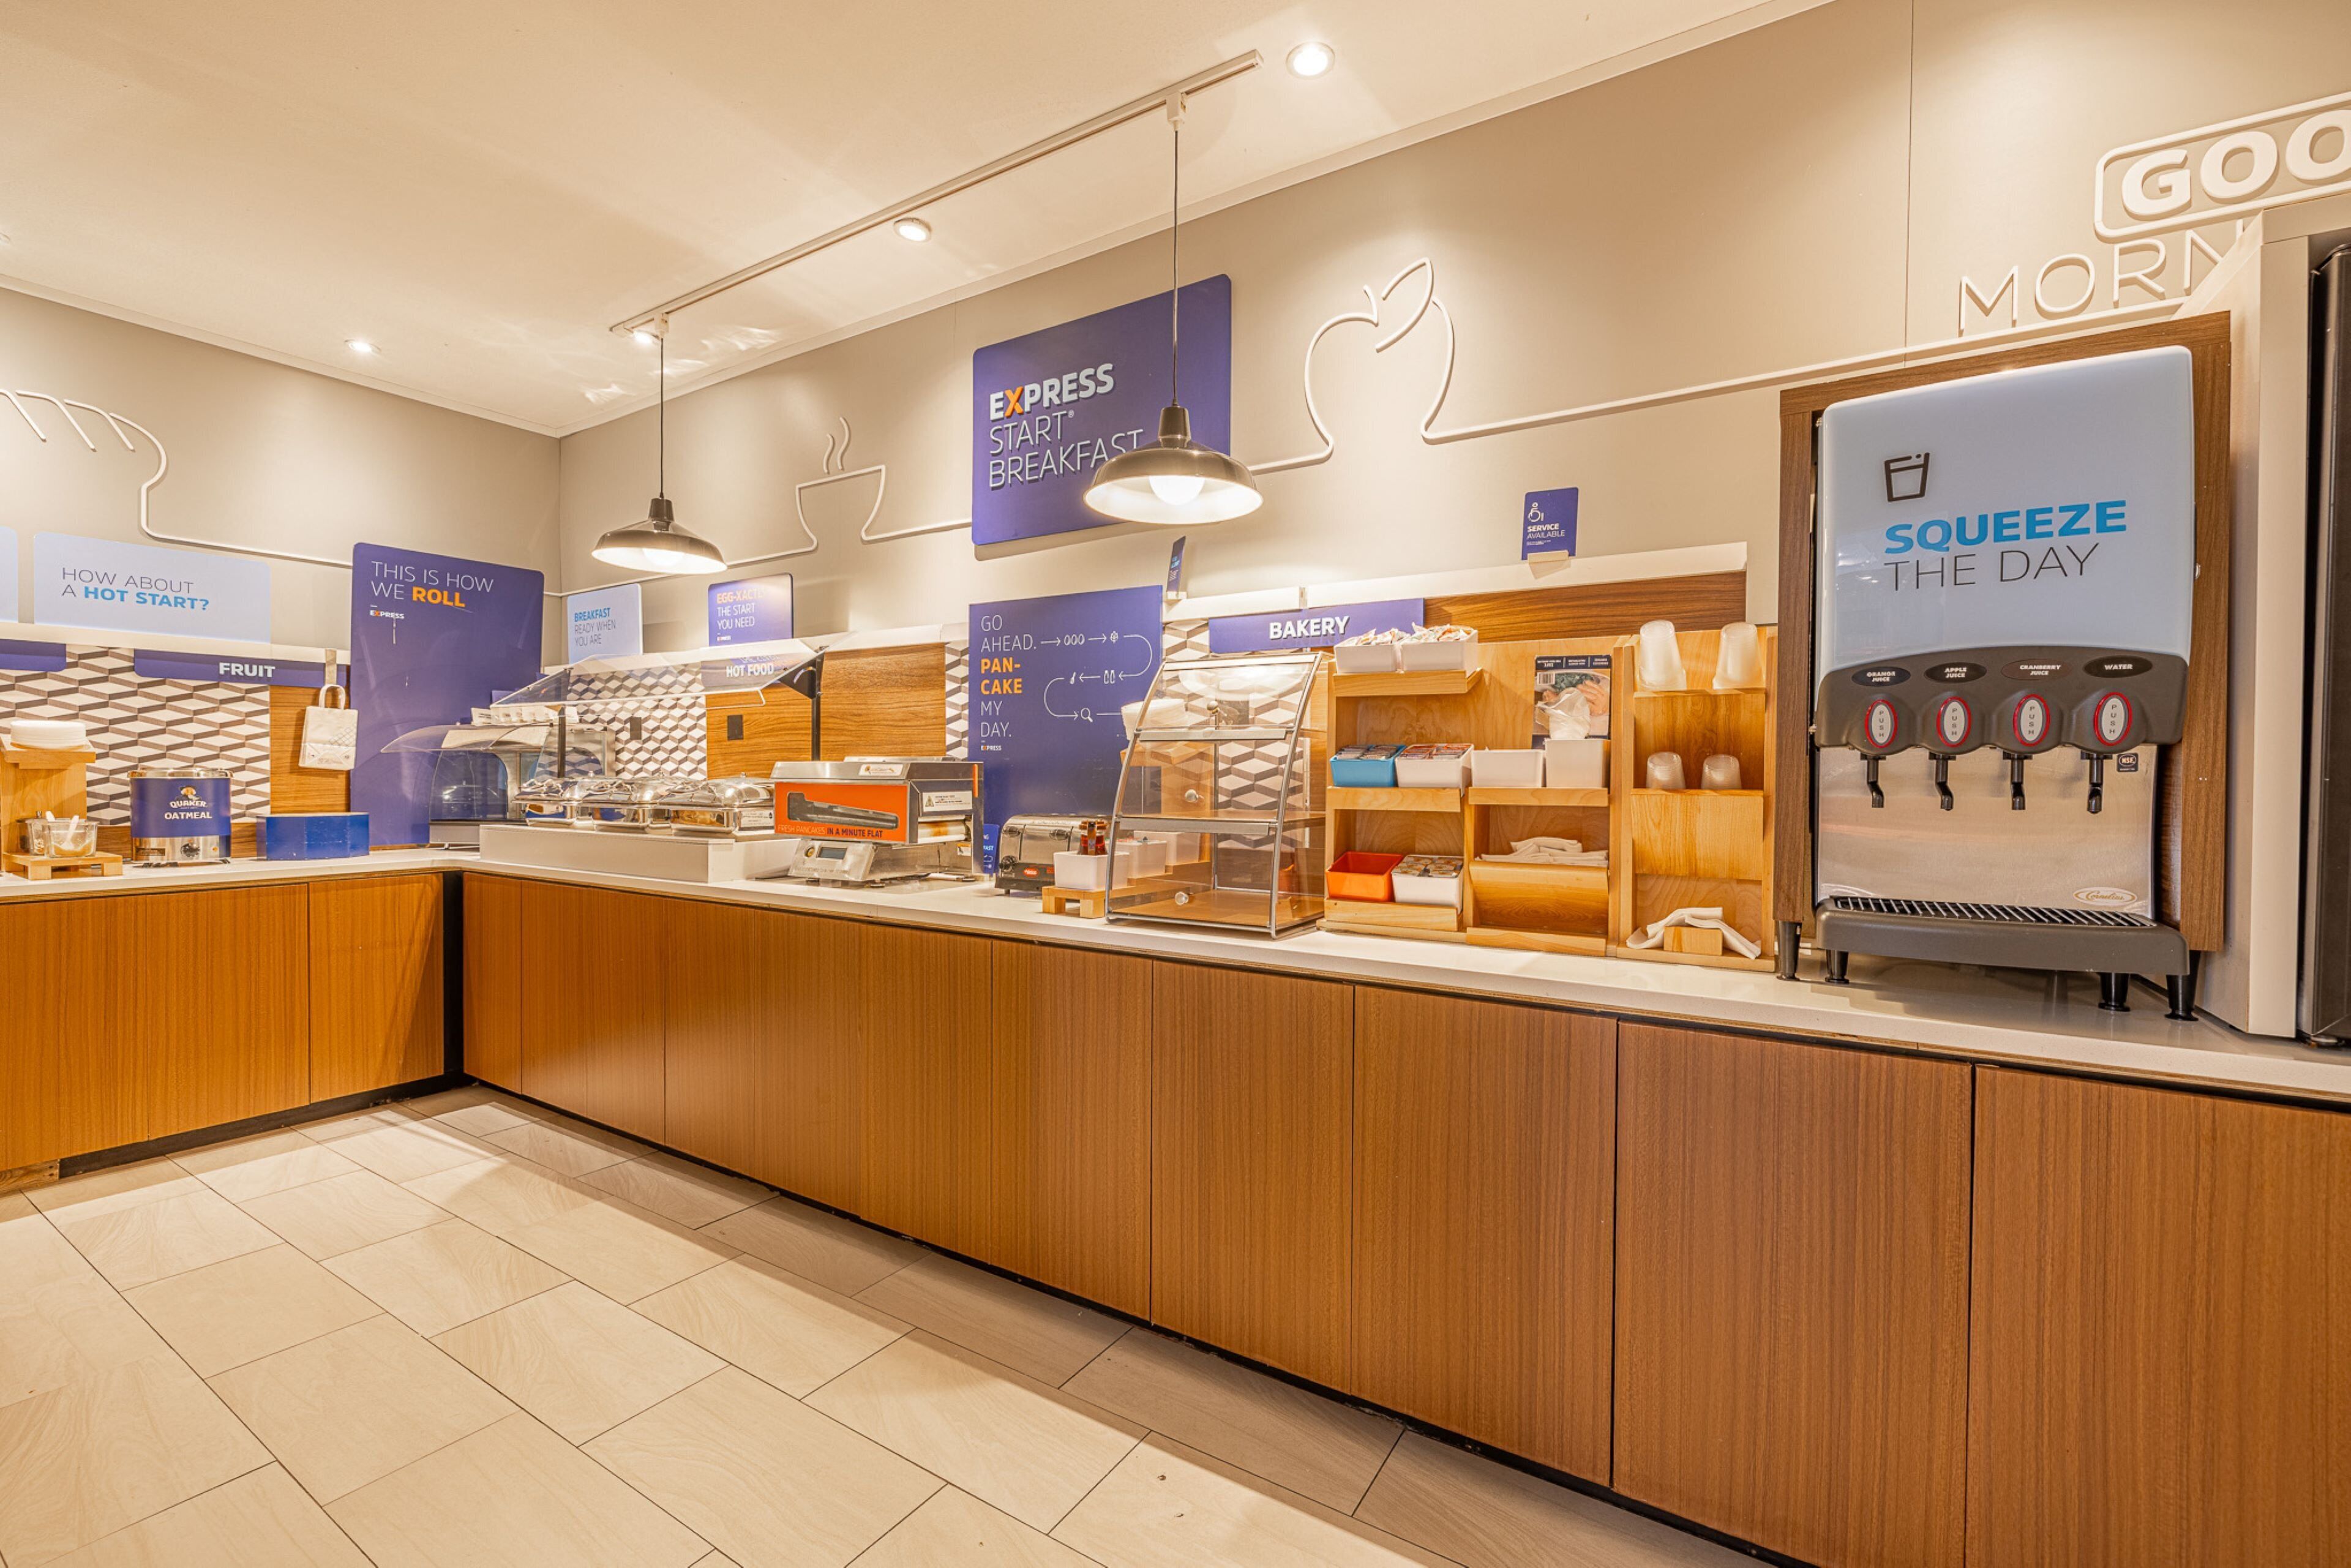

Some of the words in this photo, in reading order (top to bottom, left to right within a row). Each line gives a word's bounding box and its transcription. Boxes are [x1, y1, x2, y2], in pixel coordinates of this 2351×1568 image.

[2121, 109, 2351, 217] GOO
[990, 363, 1114, 420] EXPRESS
[989, 429, 1144, 487] BREAKFAST
[1527, 523, 1559, 533] SERVICE
[1527, 530, 1565, 539] AVAILABLE
[1884, 500, 2126, 555] SQUEEZE
[1884, 553, 1976, 591] THE
[2000, 542, 2099, 582] DAY
[62, 568, 116, 587] HOW
[124, 575, 194, 595] ABOUT
[371, 561, 416, 582] THIS
[424, 569, 439, 585] IS
[446, 572, 494, 593] HOW
[62, 584, 77, 598] A
[84, 586, 128, 602] HOT
[135, 592, 209, 610] START?
[371, 580, 404, 599] WE
[412, 586, 465, 607] ROLL
[370, 610, 404, 619] EXPRESS
[574, 607, 611, 622] BREAKFAST
[717, 606, 731, 617] THE
[733, 603, 756, 616] START
[574, 623, 594, 634] READY
[596, 620, 617, 631] WHEN
[717, 619, 733, 630] YOU
[735, 617, 755, 628] NEED
[981, 615, 1003, 632] GO
[1269, 616, 1349, 640] BAKERY
[574, 636, 588, 647] YOU
[589, 634, 602, 644] ARE
[981, 634, 1037, 653] AHEAD.
[219, 662, 276, 678] FRUIT
[726, 665, 745, 677] HOT
[748, 663, 774, 676] FOOD
[981, 657, 1021, 674] PAN-
[981, 678, 1022, 695] CAKE
[981, 700, 1003, 716] MY
[981, 721, 1012, 738] DAY.
[170, 800, 208, 809] QUAKER
[797, 826, 825, 835] PANCAKES
